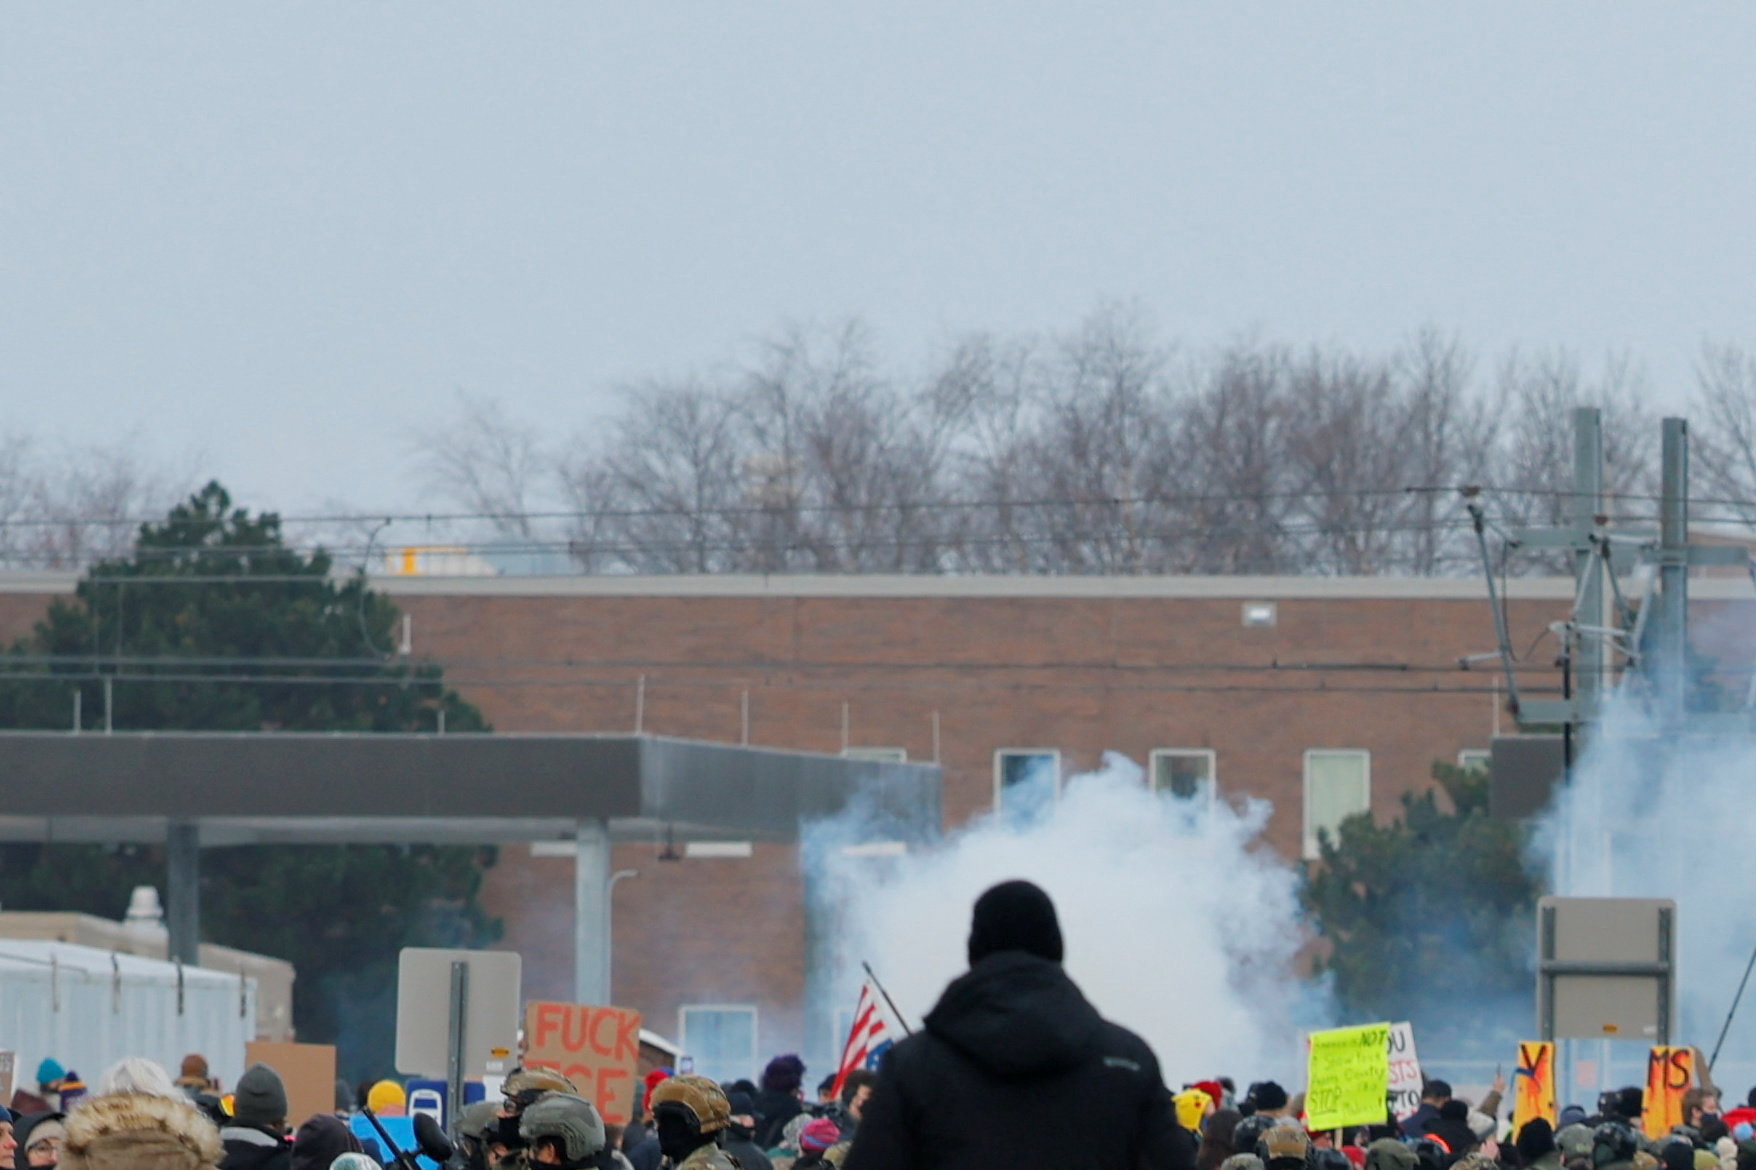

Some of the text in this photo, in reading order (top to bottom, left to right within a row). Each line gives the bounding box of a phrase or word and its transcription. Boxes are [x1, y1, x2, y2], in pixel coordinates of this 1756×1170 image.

[535, 1003, 642, 1061] FUCK
[1360, 1030, 1387, 1047] NOT
[1310, 1086, 1342, 1110] STOP
